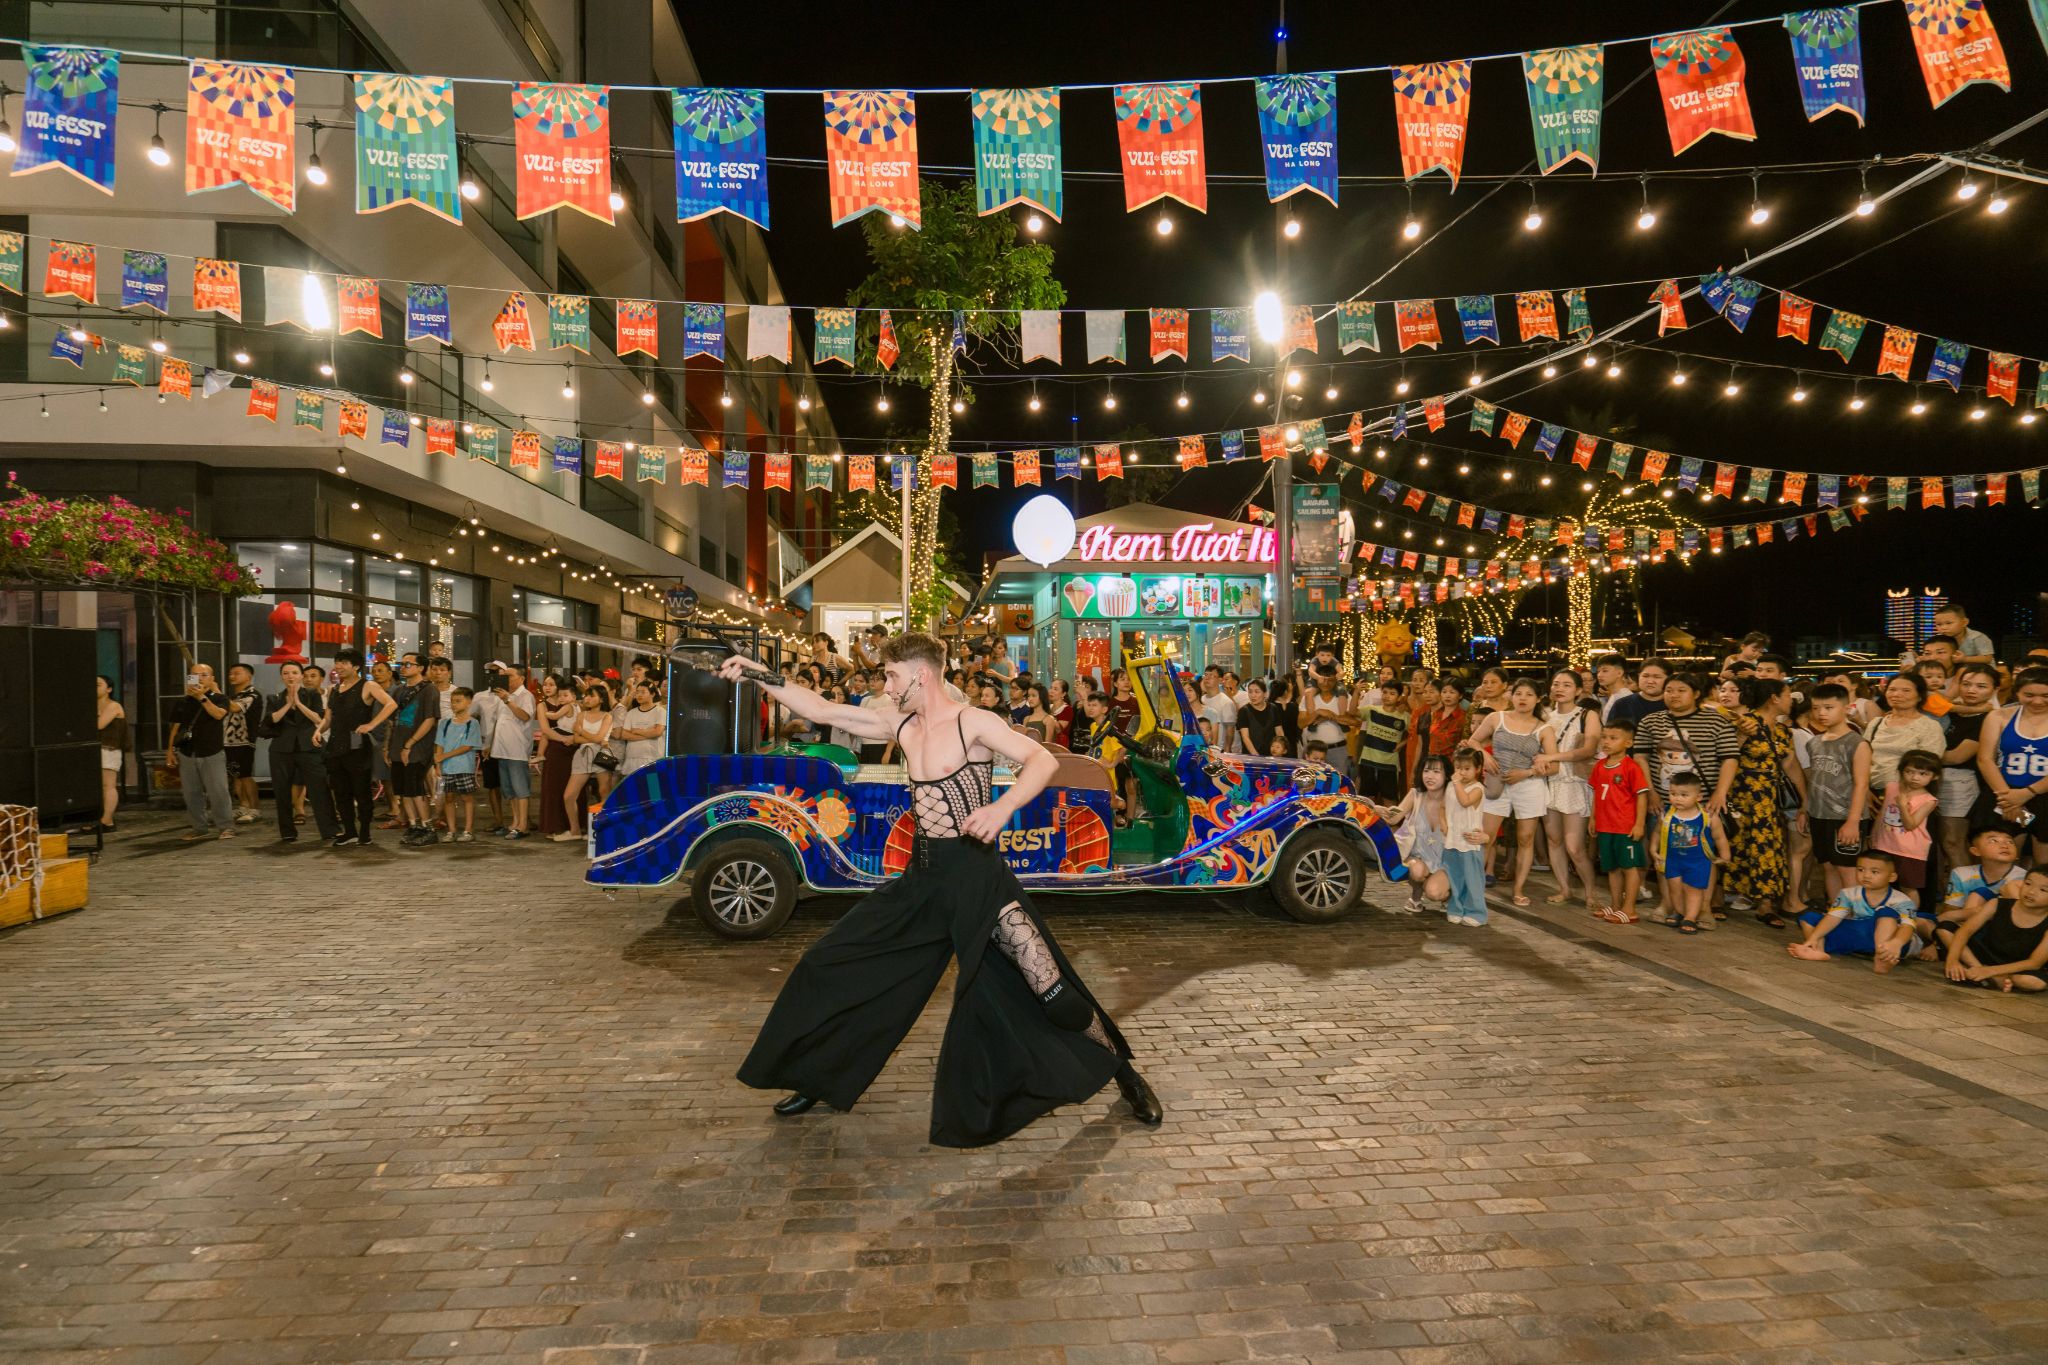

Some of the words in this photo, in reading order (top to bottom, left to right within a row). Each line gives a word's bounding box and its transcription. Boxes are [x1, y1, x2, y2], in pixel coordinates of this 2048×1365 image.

[1923, 51, 1949, 66] VUI
[1955, 37, 1992, 59] FEST
[1958, 56, 1983, 69] LONG
[1801, 66, 1825, 80] VUI
[1829, 64, 1859, 79] FEST
[1669, 91, 1700, 110] VUI
[1705, 82, 1740, 102] FEST
[1706, 101, 1729, 111] LONG
[26, 112, 49, 129] VUI
[56, 114, 106, 138] FEST
[1539, 111, 1568, 129] VUI
[1572, 110, 1600, 125] FEST
[53, 135, 82, 146] LONG
[1404, 122, 1430, 137] VUI
[1435, 123, 1464, 141] FEST
[197, 128, 230, 148] VUI
[239, 137, 288, 159] FEST
[1267, 143, 1293, 159] VUI
[1299, 141, 1333, 158] FEST
[233, 156, 264, 167] LONG
[366, 148, 399, 167] VUI
[406, 152, 448, 170] FEST
[524, 154, 554, 170] VUI
[562, 157, 603, 175] FEST
[982, 153, 1010, 169] VUI
[1017, 154, 1055, 170] FEST
[1127, 151, 1153, 166] VUI
[1161, 149, 1198, 166] FEST
[681, 161, 711, 177] VUI
[719, 162, 760, 180] FEST
[835, 160, 864, 176] VUI
[870, 162, 911, 177] FEST
[702, 332, 721, 340] FEST
[1080, 525, 1165, 562] Kem
[1171, 522, 1244, 562] Tươi
[1246, 526, 1277, 562] It
[668, 596, 693, 608] WC
[2006, 753, 2048, 776] 98
[1601, 784, 1609, 800] 7
[999, 827, 1056, 852] FEST
